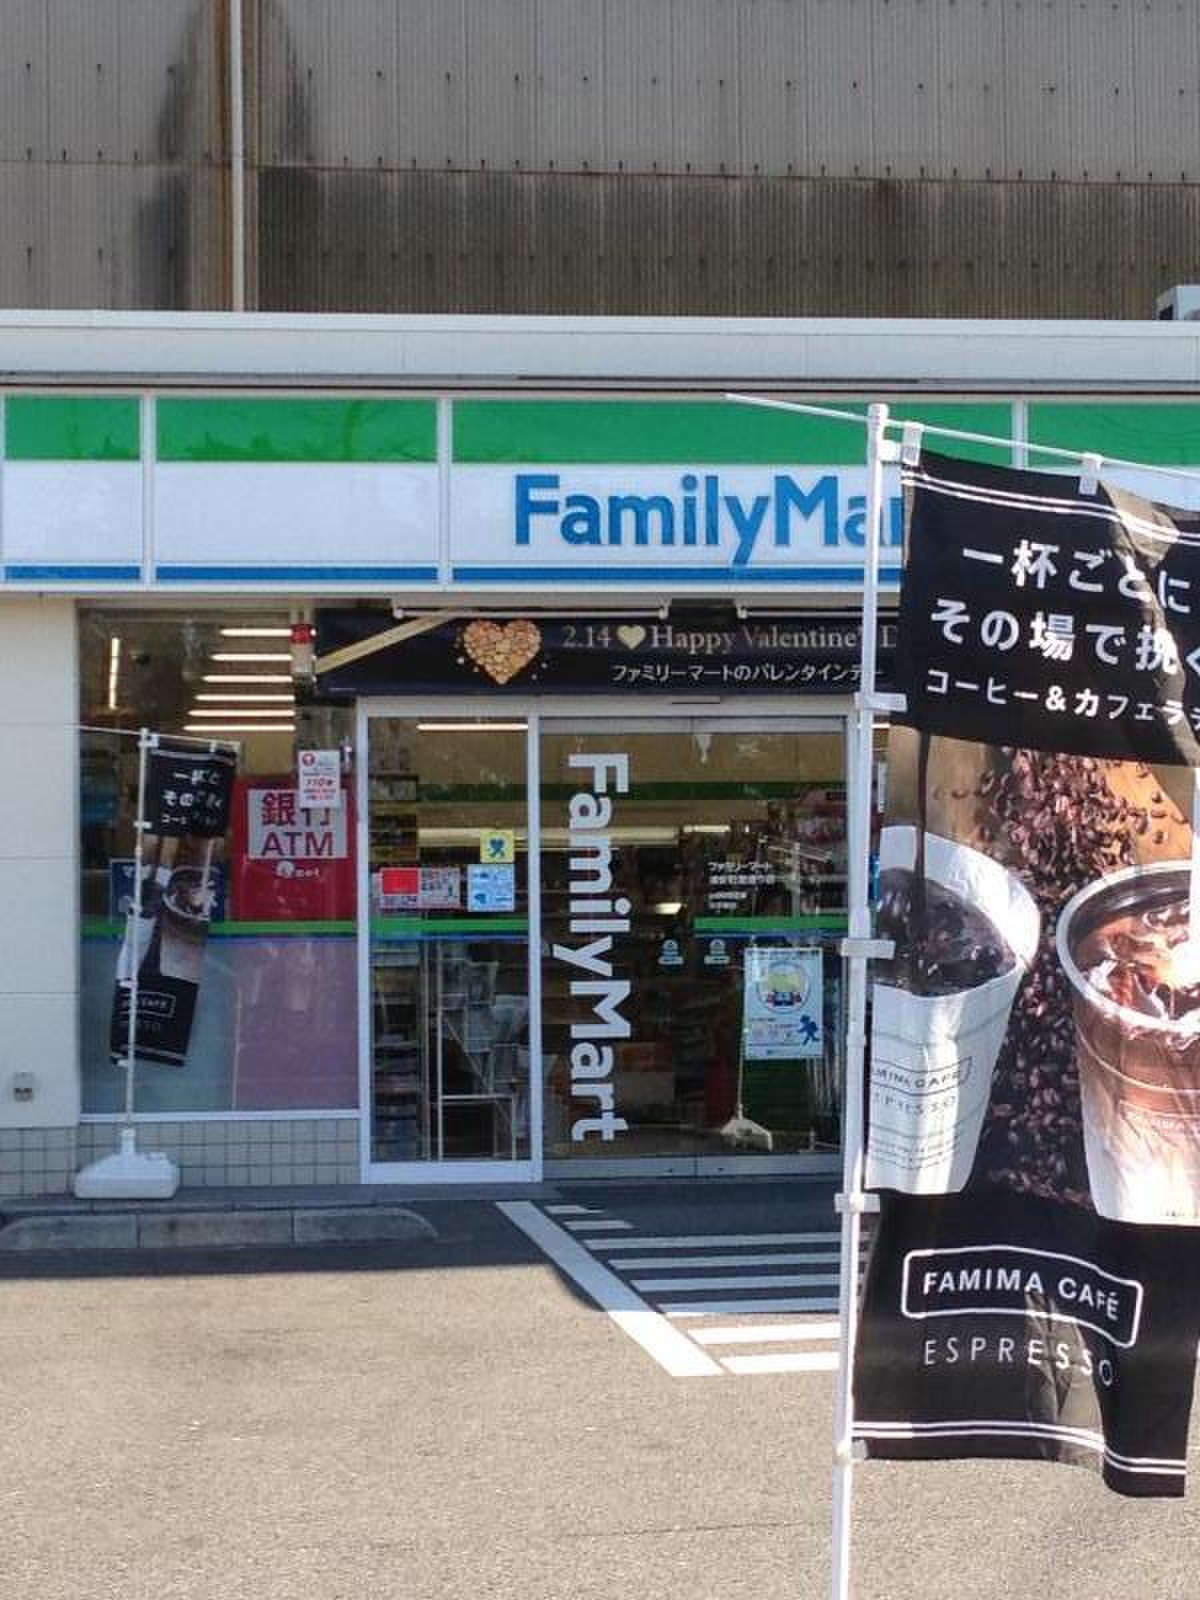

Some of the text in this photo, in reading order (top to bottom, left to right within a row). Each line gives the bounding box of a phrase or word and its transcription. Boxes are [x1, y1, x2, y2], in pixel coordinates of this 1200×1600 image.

[963, 539, 1191, 614] 一杯ごとに
[561, 624, 612, 648] 2.14
[651, 624, 736, 655] Happy
[741, 625, 864, 648] Valentine'
[260, 830, 334, 857] ATM
[552, 752, 632, 1142] FamilyMart
[922, 1268, 1120, 1321] FAMIMA CAFÉ
[923, 1337, 1115, 1386] ESPRESSO
